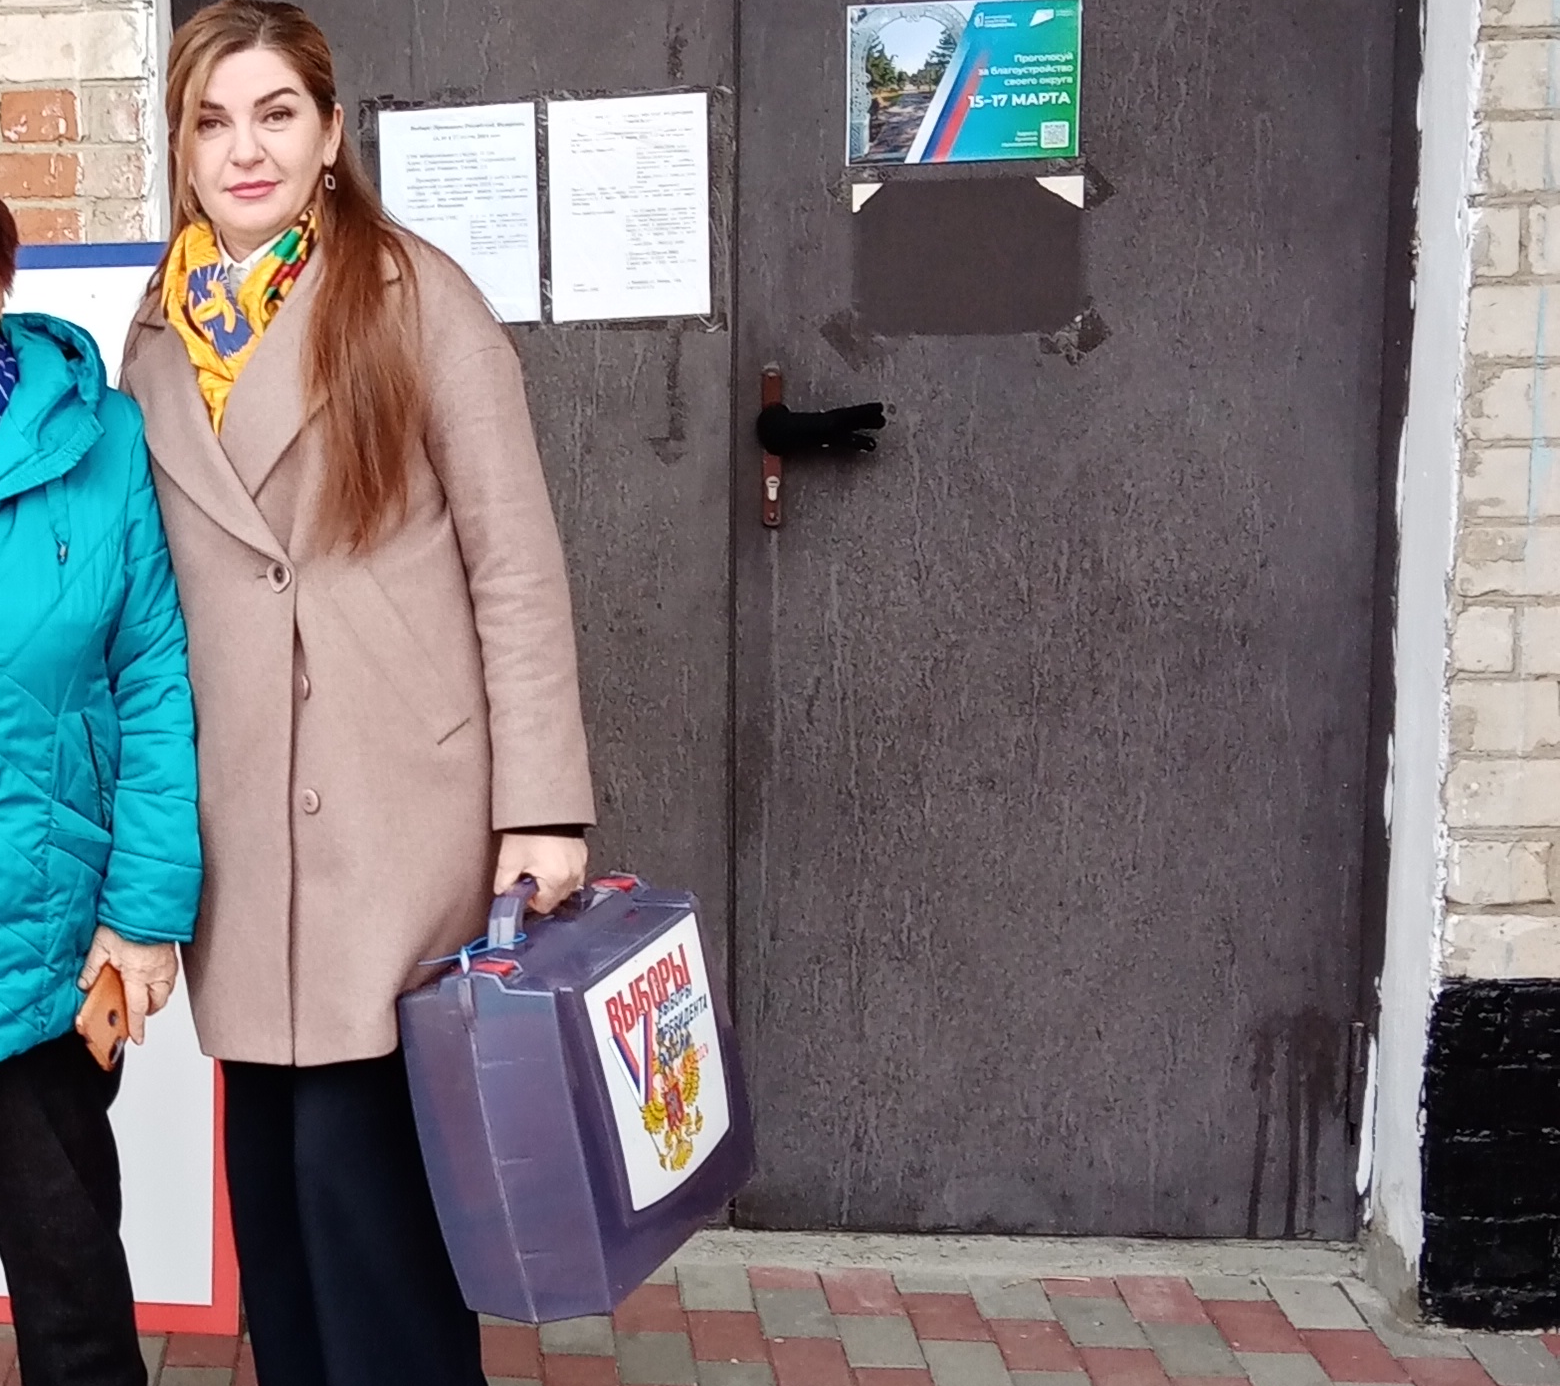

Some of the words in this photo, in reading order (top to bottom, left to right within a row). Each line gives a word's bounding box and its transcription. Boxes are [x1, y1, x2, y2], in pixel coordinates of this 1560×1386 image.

[1014, 51, 1074, 63] Проголосуй
[977, 68, 989, 76] за
[990, 64, 1074, 76] благоустройство
[1004, 77, 1037, 86] своего
[1039, 76, 1073, 86] округа
[1011, 91, 1071, 106] МАРТА
[605, 943, 692, 1034] ВЫБОРЫ
